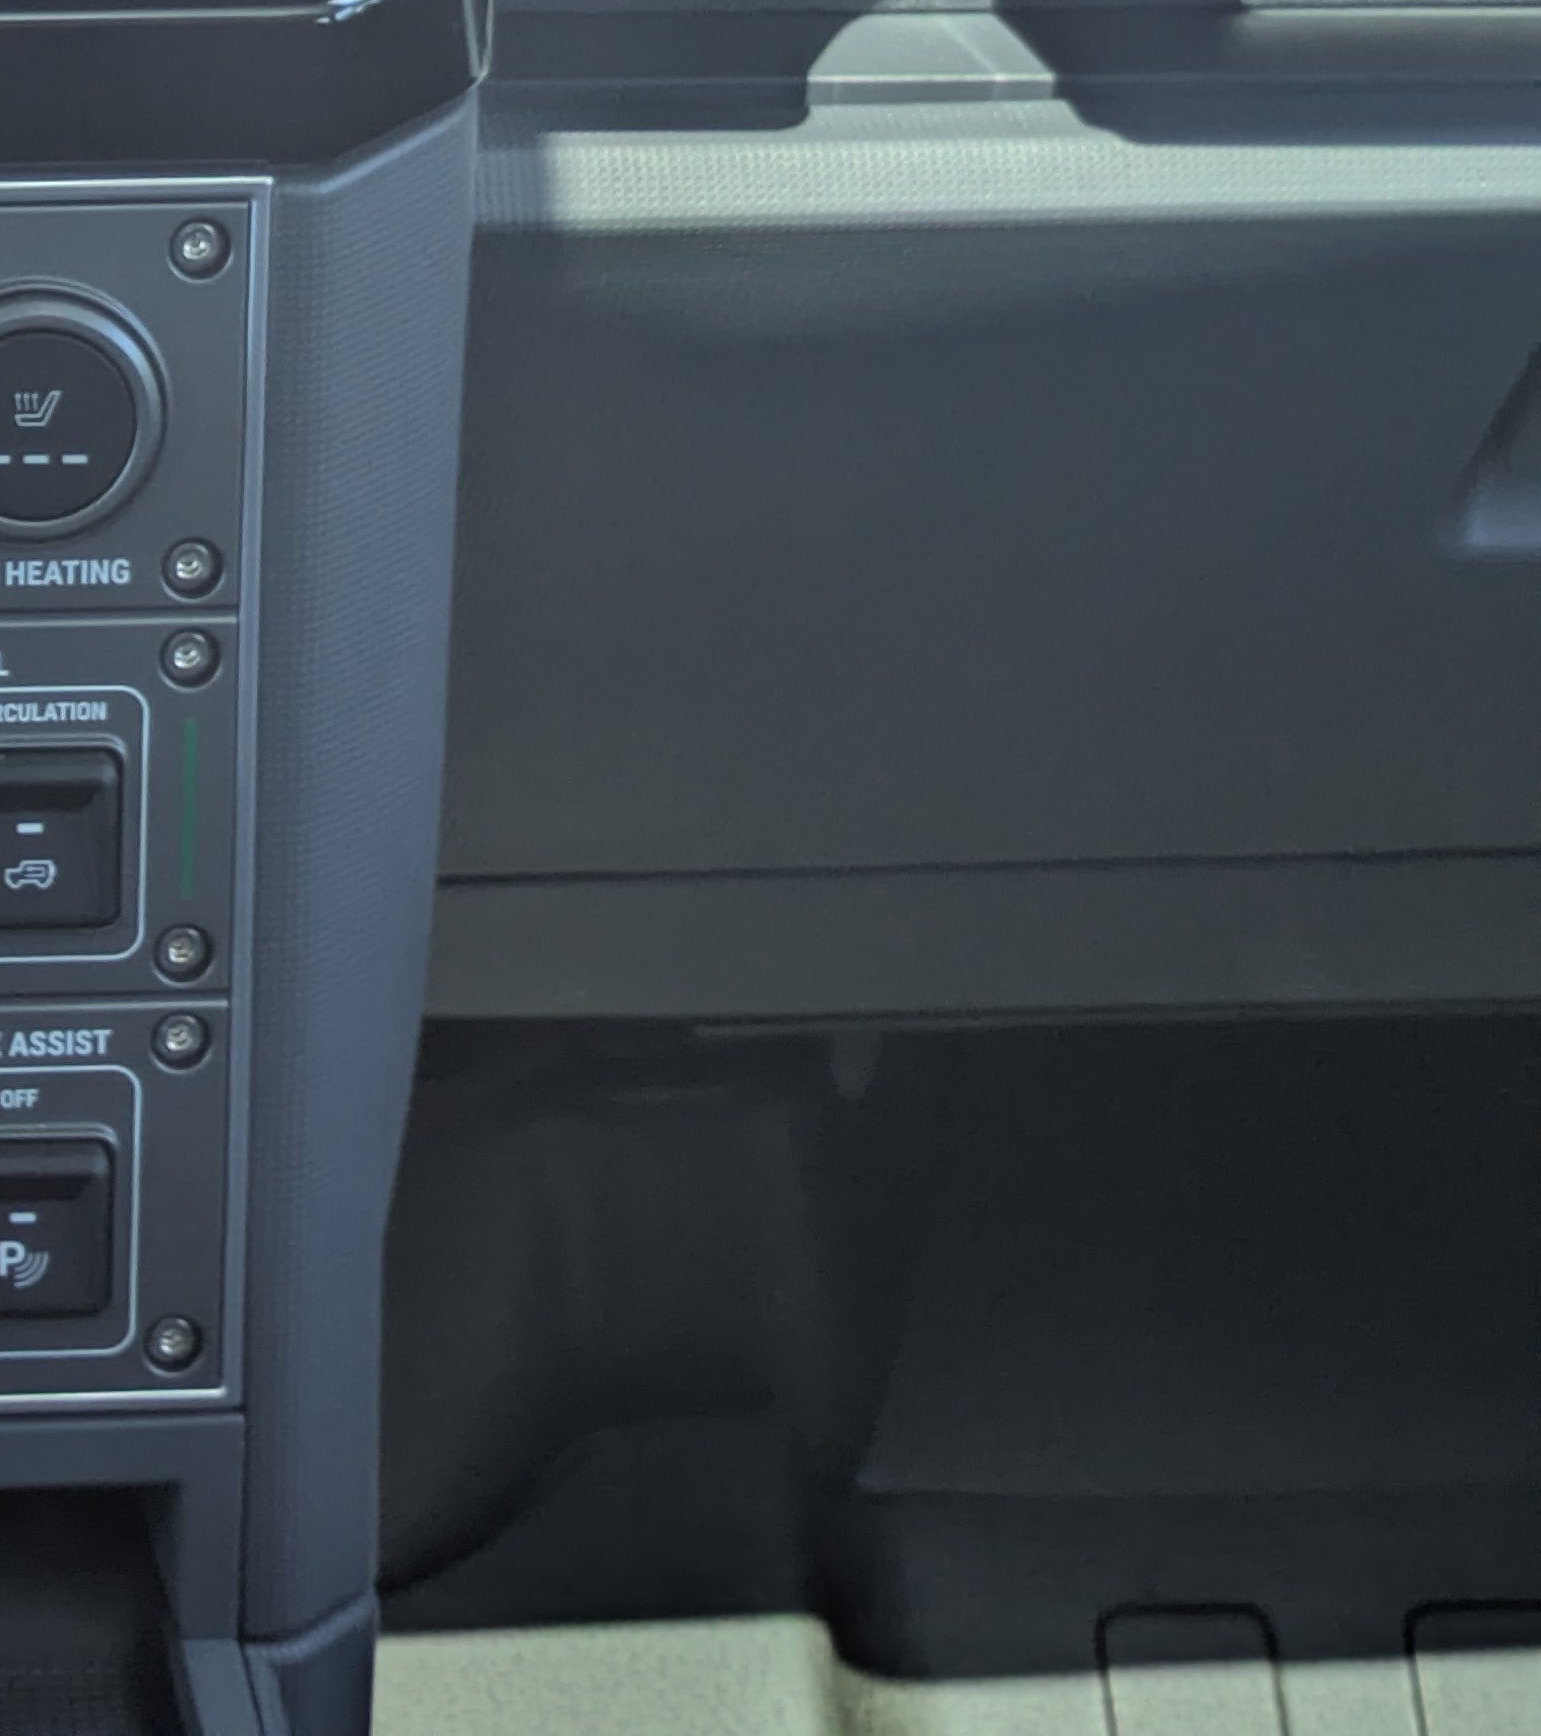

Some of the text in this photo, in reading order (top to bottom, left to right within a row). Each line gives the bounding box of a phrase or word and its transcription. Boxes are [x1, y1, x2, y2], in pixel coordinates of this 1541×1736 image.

[5, 558, 131, 586] HEATING
[8, 1028, 112, 1057] ASSIST
[0, 1088, 39, 1109] OFF
